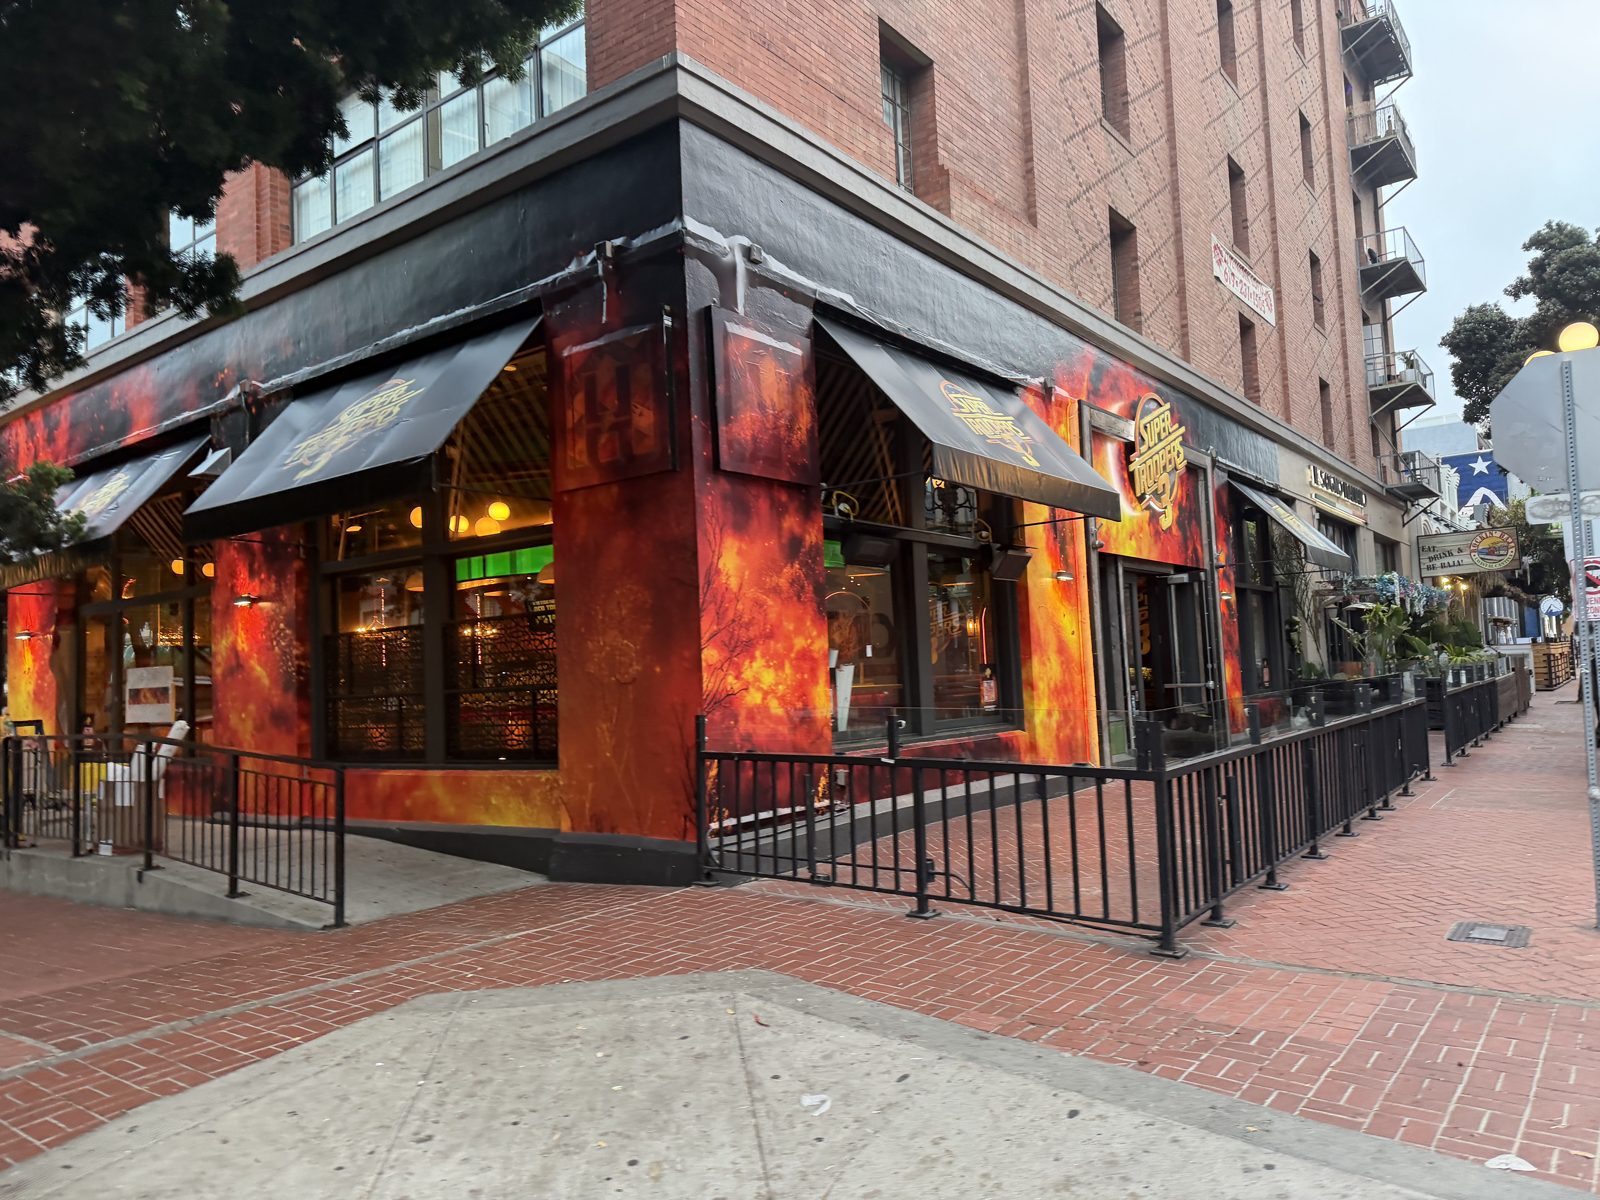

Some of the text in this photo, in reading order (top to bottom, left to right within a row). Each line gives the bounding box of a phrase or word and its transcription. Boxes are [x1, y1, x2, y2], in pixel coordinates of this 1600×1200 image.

[949, 394, 1004, 416] SUPER
[953, 412, 1032, 440] TROOPERS
[1139, 402, 1178, 453] SUPER
[1129, 426, 1187, 497] TROOPERS
[1158, 472, 1173, 530] 3
[1499, 531, 1516, 550] BAJA
[1426, 563, 1438, 571] BE
[1428, 550, 1454, 563] DRINK
